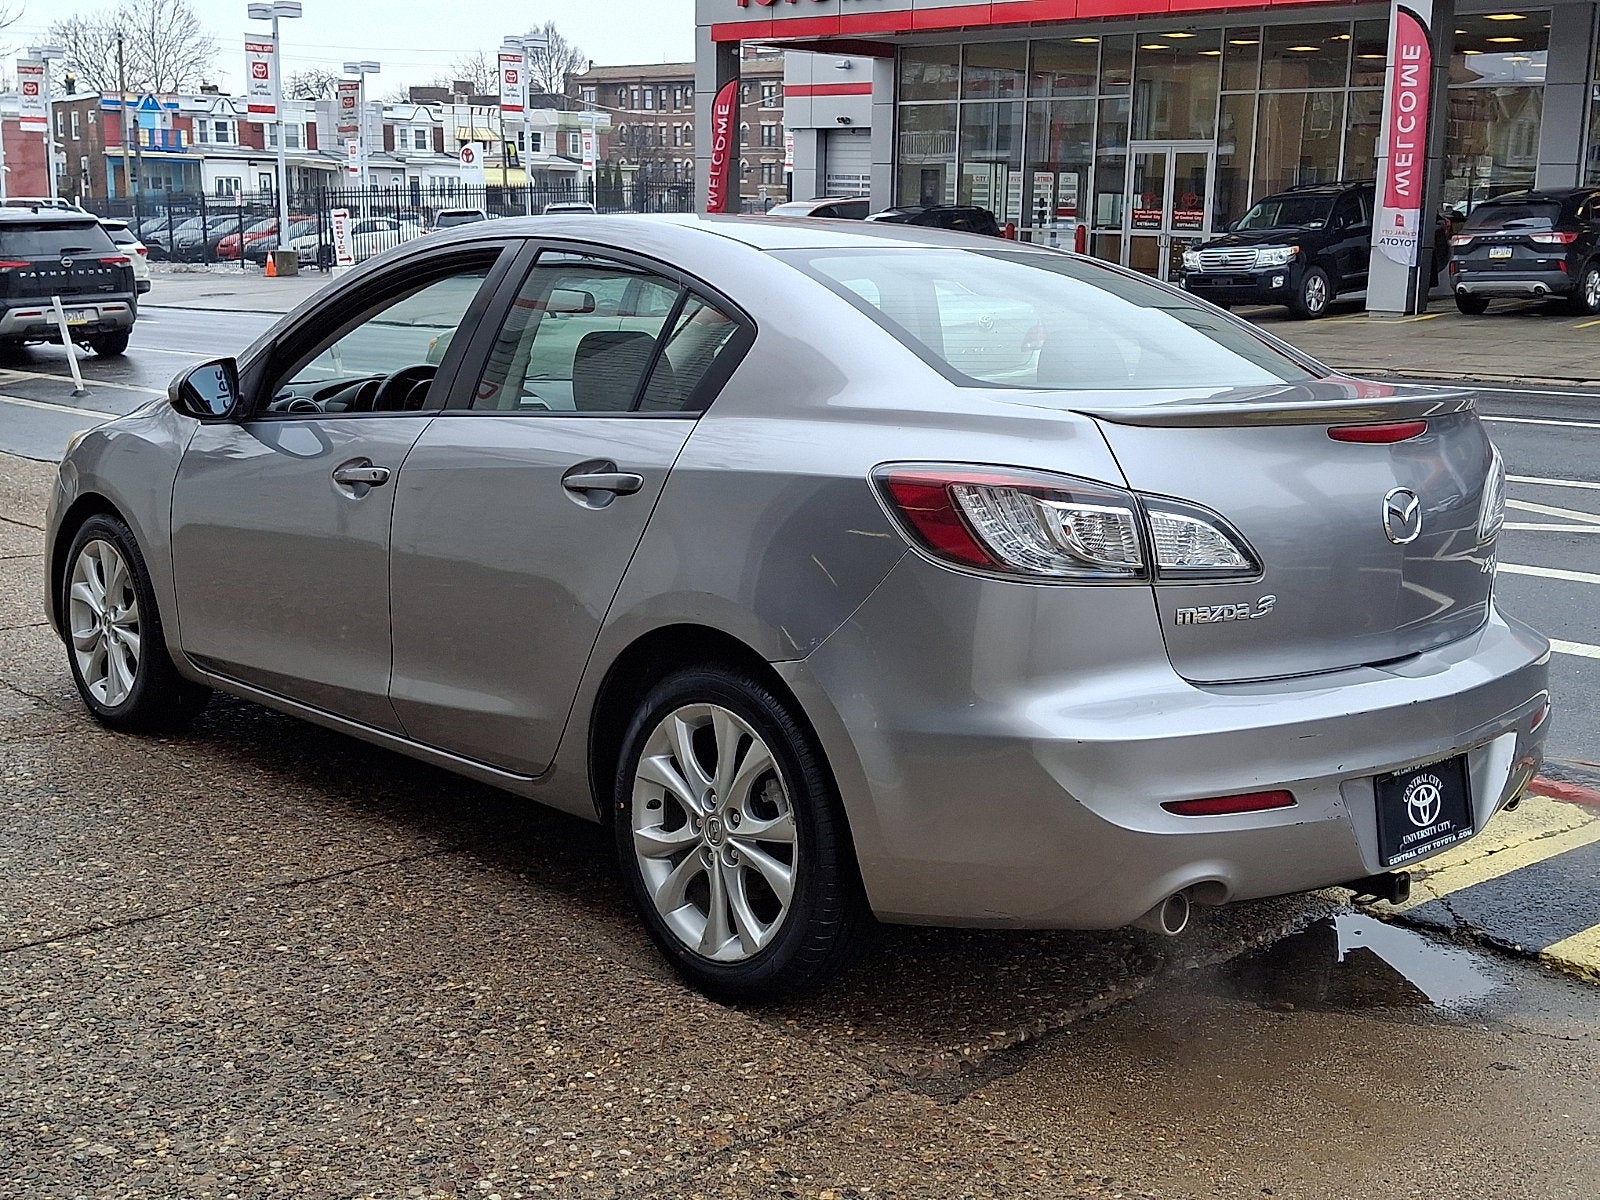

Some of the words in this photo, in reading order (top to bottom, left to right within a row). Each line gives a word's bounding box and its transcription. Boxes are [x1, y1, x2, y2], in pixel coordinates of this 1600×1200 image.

[707, 103, 730, 207] WELCOME
[335, 220, 347, 255] SERVICE
[19, 267, 112, 279] PATHFINDER
[1402, 773, 1428, 803] CENTRAL
[1428, 773, 1445, 791] CITY
[1402, 827, 1437, 845] UNIVERSITY
[1437, 820, 1452, 834] CITY
[1388, 850, 1417, 866] CENTRAL
[1417, 843, 1432, 855] CITY
[1433, 835, 1457, 849] TOYOTA
